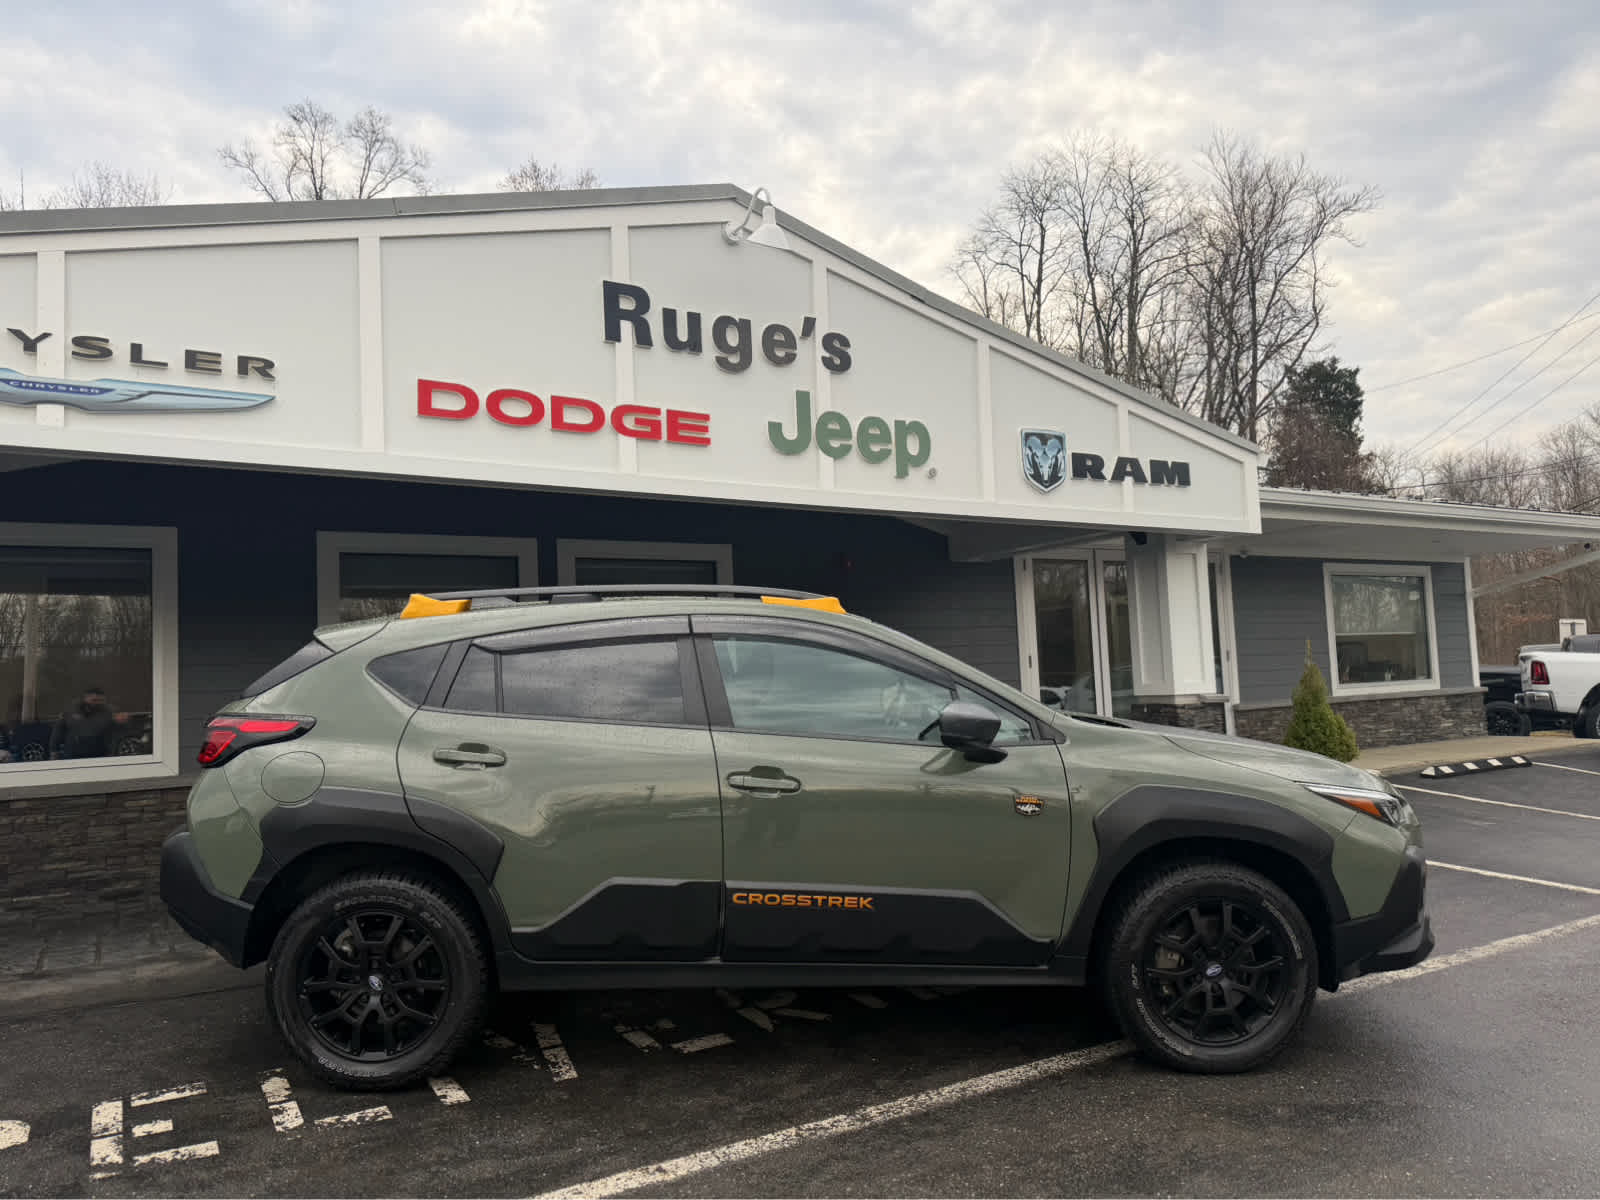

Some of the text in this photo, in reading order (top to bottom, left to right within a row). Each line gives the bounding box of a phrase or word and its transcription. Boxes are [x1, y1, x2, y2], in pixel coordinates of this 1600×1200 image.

[6, 328, 276, 381] YSLER
[602, 280, 852, 374] Ruge's
[416, 378, 711, 446] DODGE
[767, 390, 932, 479] Jeep
[1071, 452, 1191, 486] RAM
[732, 892, 874, 910] CROSSTREK
